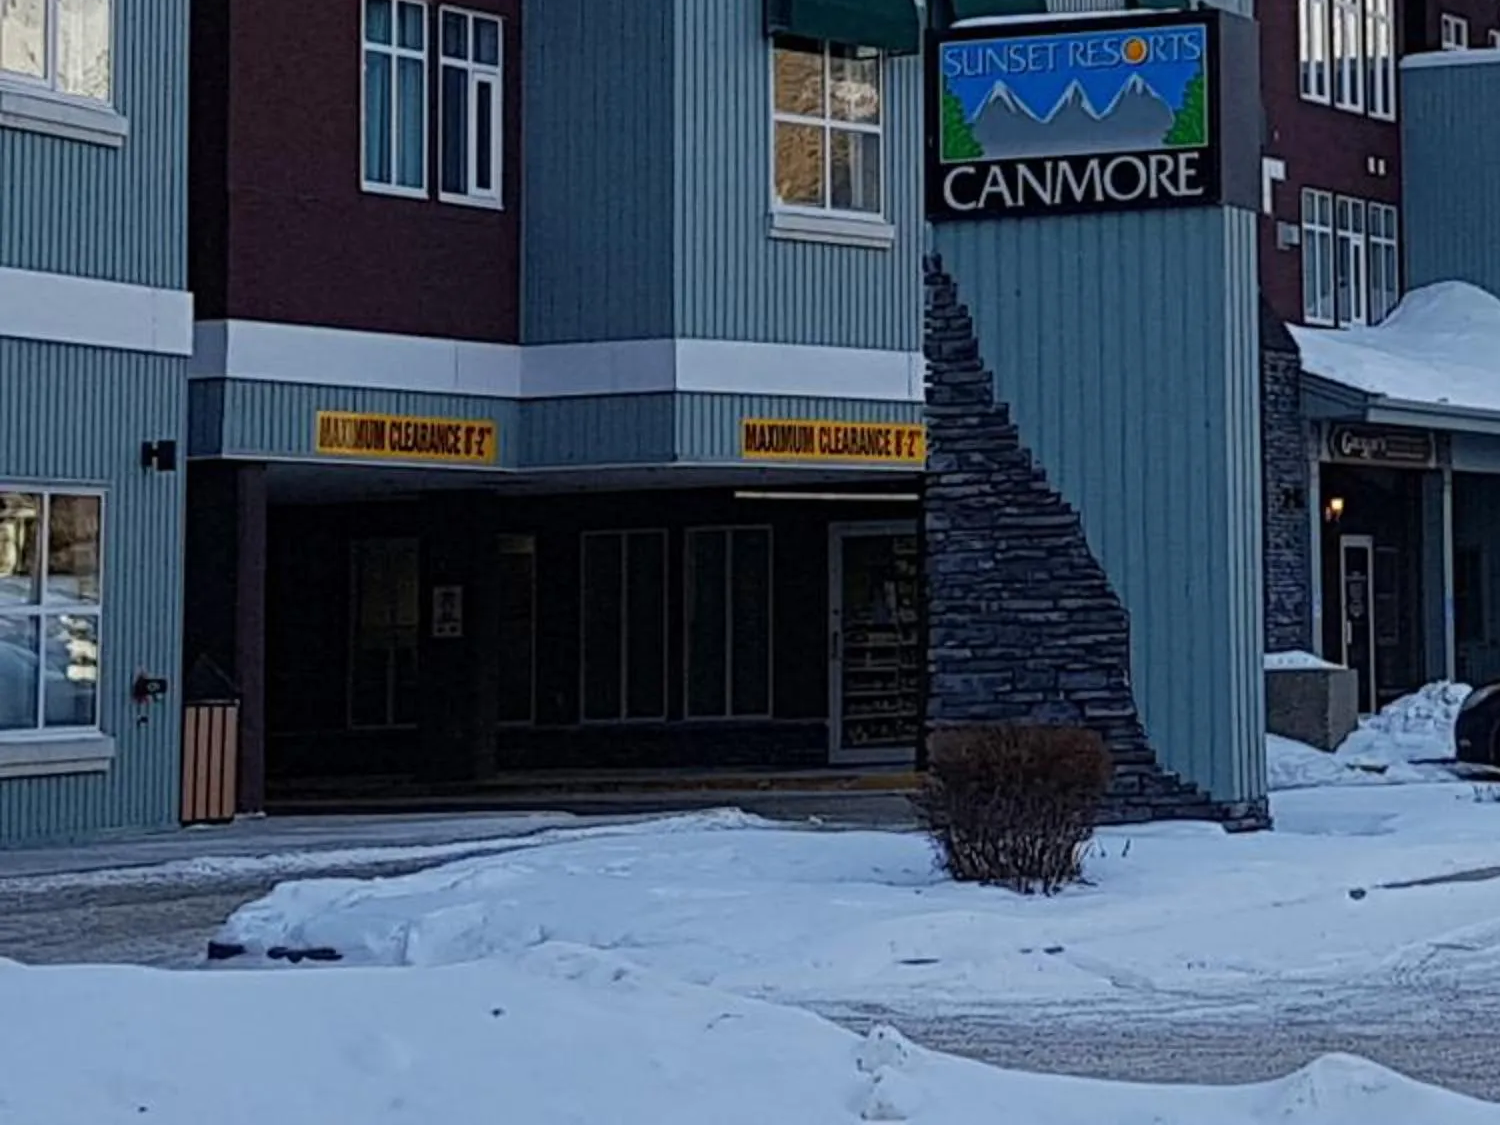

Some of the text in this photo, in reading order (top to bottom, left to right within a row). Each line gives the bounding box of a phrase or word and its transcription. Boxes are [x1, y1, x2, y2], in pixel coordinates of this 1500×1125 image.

[944, 31, 1201, 77] SUNSET RESORTS
[943, 151, 1204, 211] CANMORE
[320, 416, 386, 450] MAXIMUM
[389, 420, 461, 455] CLEARANCE
[745, 423, 815, 453] MAXIMUM
[818, 426, 892, 456] CLEARANCE
